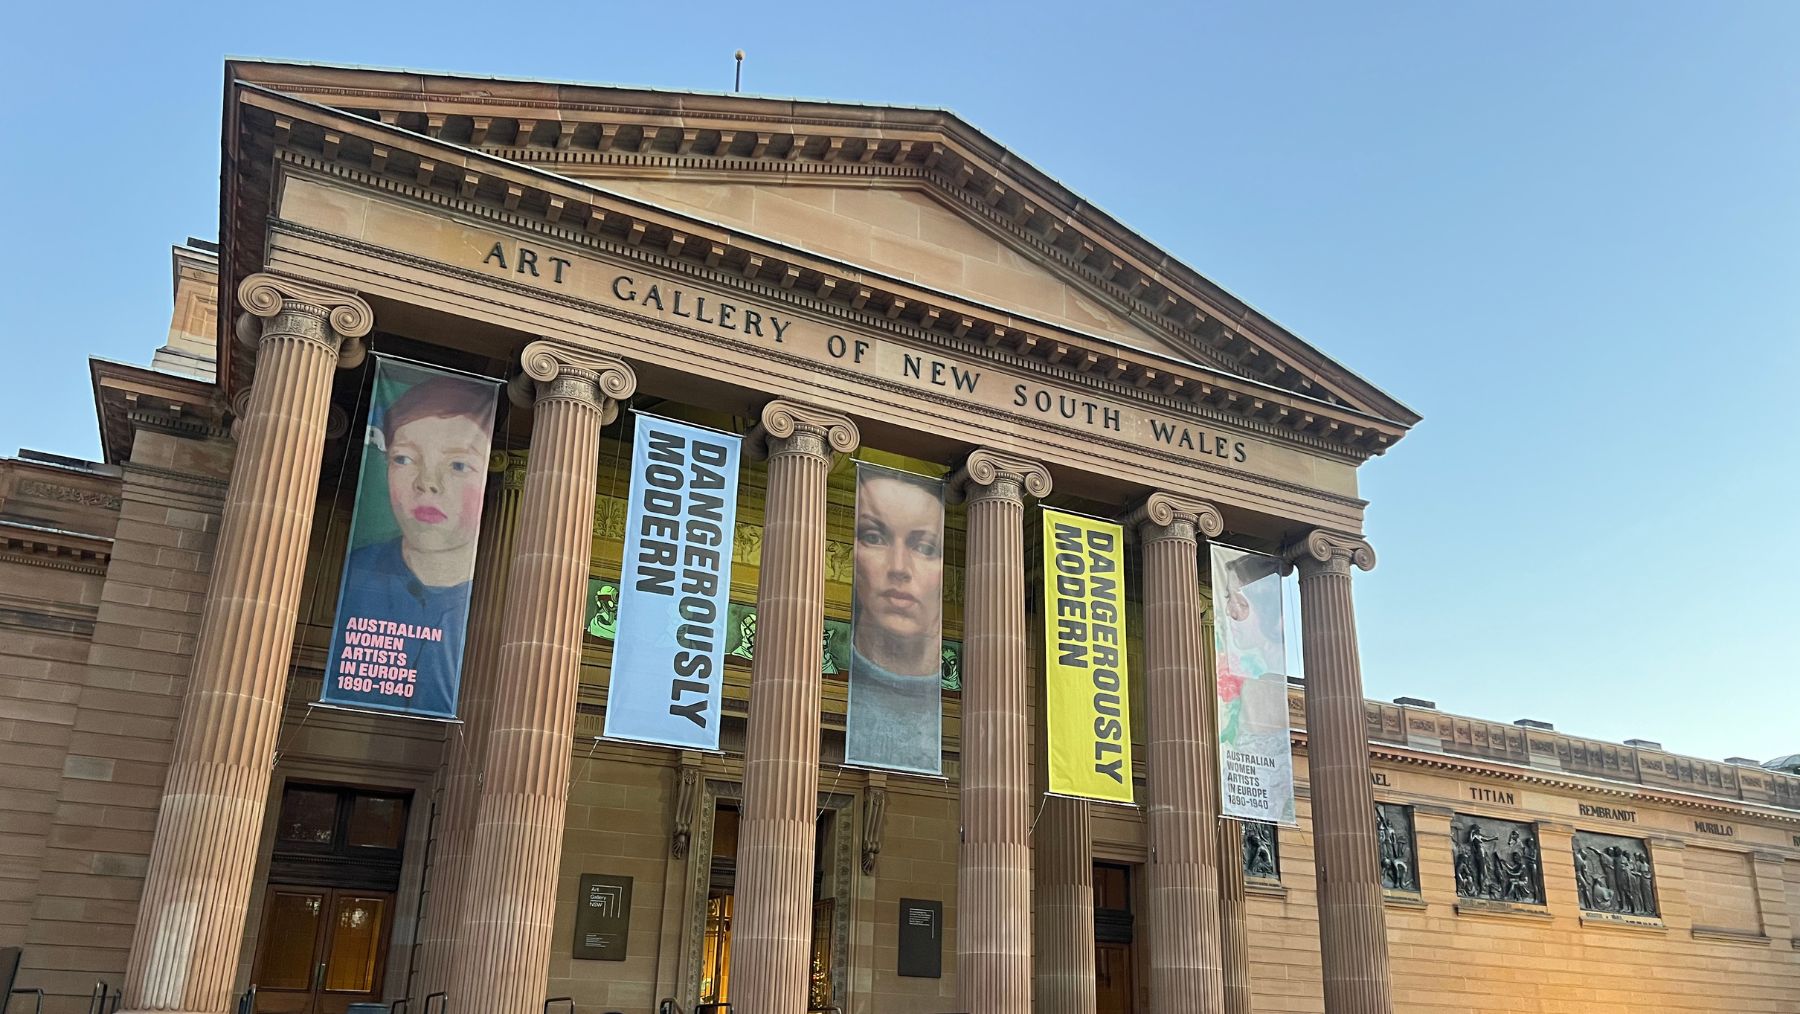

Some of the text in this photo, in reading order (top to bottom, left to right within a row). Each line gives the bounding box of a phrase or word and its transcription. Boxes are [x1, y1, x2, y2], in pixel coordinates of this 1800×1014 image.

[483, 241, 1247, 463] ART GALLERY OF NEW SOUTH WALES
[635, 430, 686, 597] MODERN
[669, 439, 728, 729] DANGEROUSLY
[1054, 522, 1089, 669] MODERN
[346, 617, 443, 642] AUSTRALIAN
[345, 631, 404, 651] WOMEN
[341, 646, 407, 666] ARTISTS
[1086, 530, 1123, 784] DANGEROUSLY
[339, 661, 417, 683] IN EUROPE
[1226, 750, 1275, 768] AUSTRALIAN
[1226, 761, 1256, 775] WOMEN
[1227, 772, 1260, 787] ARTISTS
[1228, 783, 1267, 798] IN EUROPE
[1469, 787, 1514, 805] TITIAN
[1578, 803, 1636, 822] REMBRANDT
[1695, 821, 1733, 836] MURILLO
